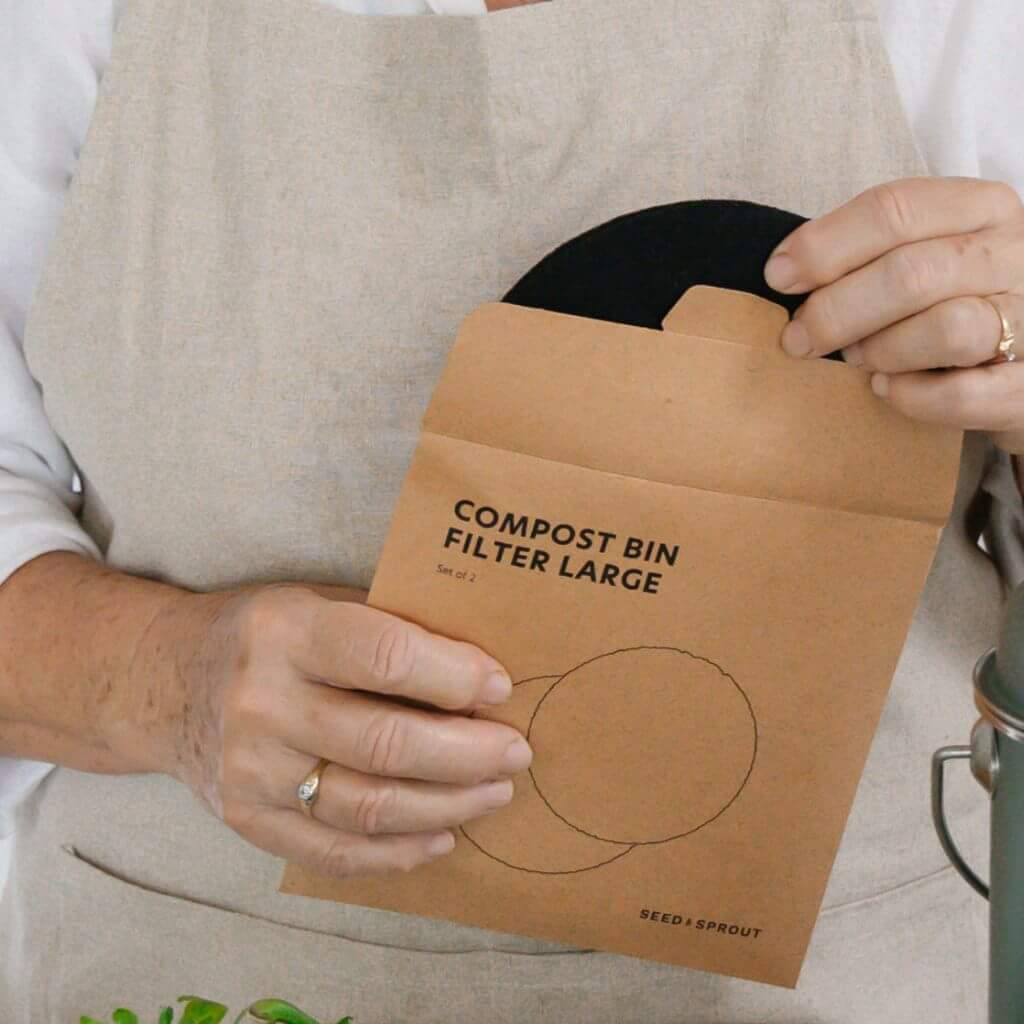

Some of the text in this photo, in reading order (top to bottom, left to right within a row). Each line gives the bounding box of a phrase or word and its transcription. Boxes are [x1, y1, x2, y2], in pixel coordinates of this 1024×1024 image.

[443, 527, 663, 595] FILTER LARGE
[454, 499, 680, 567] COMPOST BIN
[640, 909, 683, 925] SEED
[696, 919, 763, 939] SPROUT
